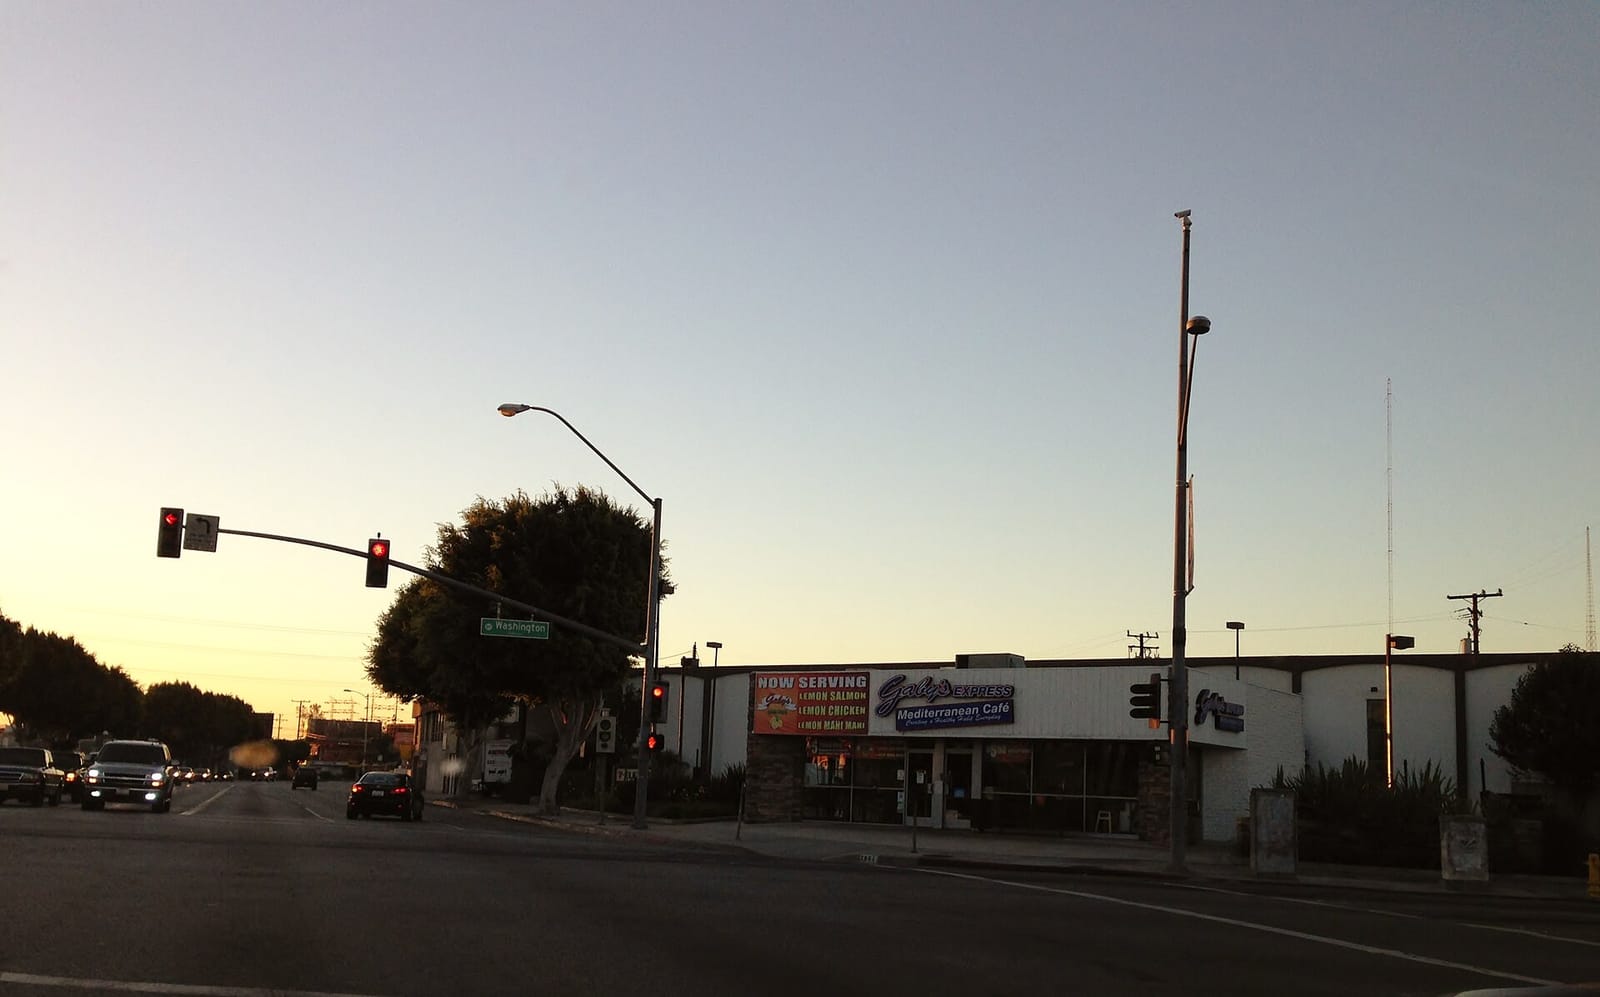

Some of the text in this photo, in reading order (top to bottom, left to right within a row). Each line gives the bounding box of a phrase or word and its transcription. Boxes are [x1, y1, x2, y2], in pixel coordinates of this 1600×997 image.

[496, 621, 546, 634] Washington
[758, 676, 868, 689] NOW SERVING
[799, 691, 867, 701] LEMON SALMON
[875, 673, 1015, 718] Gaby's EXPRESS
[798, 705, 866, 716] LEMON CHICKEN
[897, 702, 1010, 720] Mediterranean Café
[798, 720, 865, 730] LEMON MAHI MAHI
